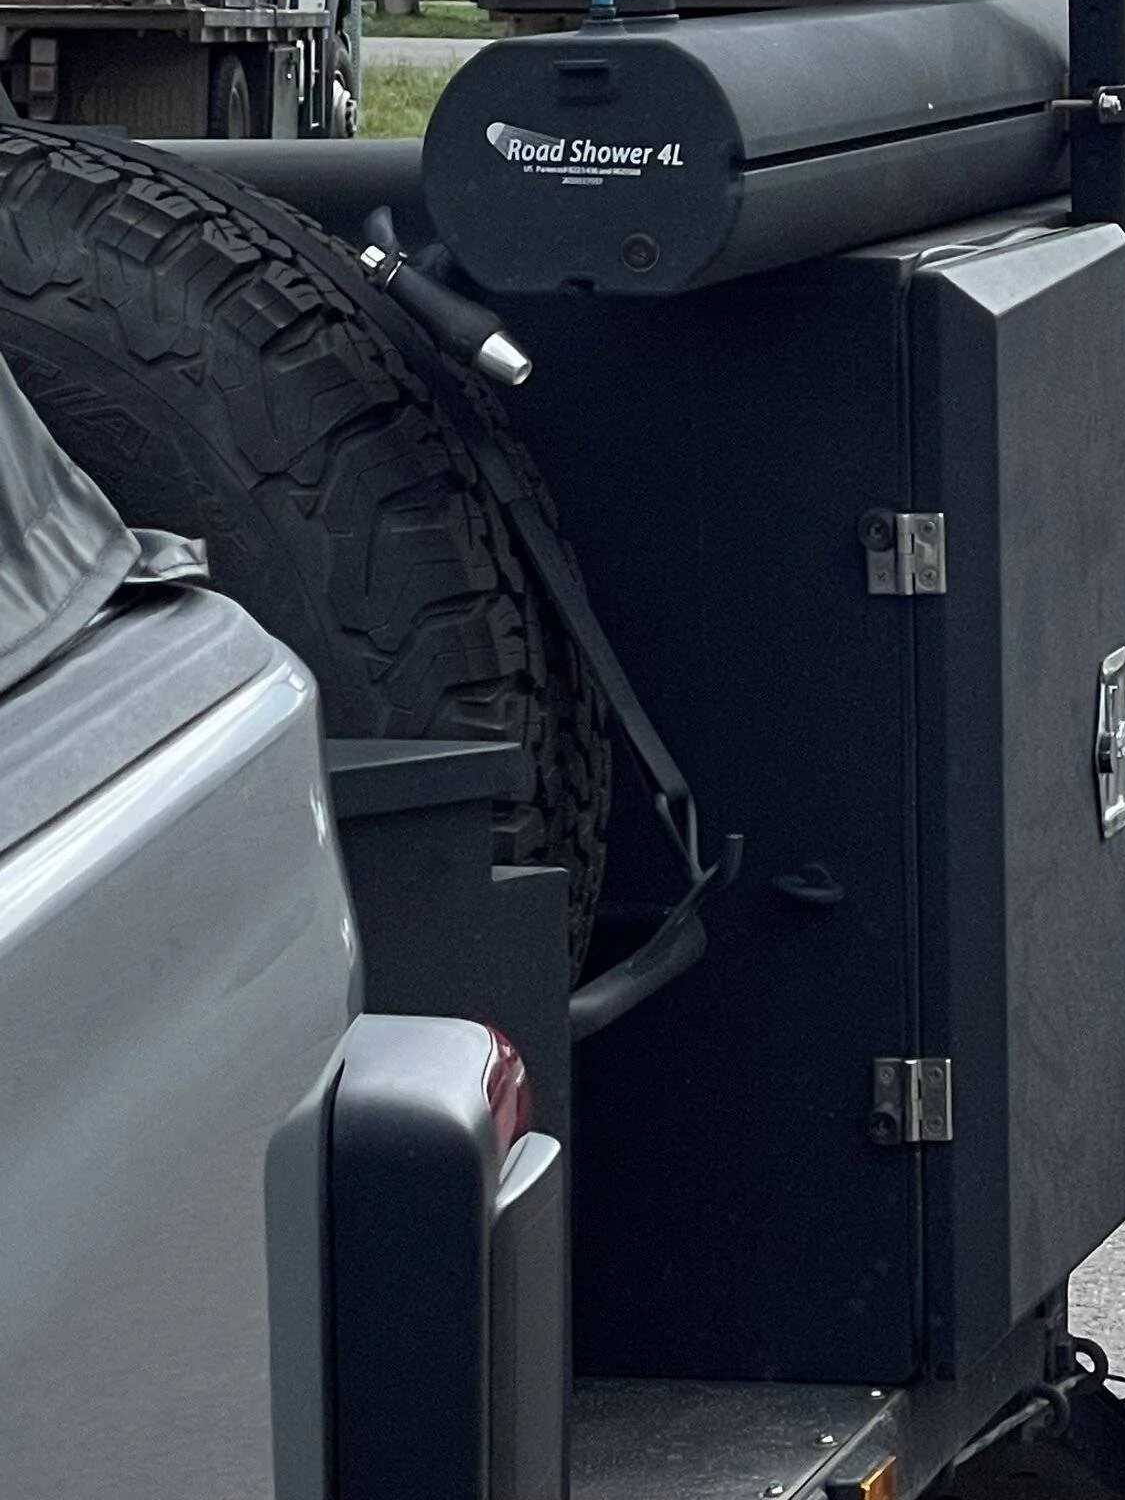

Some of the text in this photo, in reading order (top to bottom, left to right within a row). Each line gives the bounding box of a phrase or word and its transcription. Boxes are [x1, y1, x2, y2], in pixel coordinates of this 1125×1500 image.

[507, 138, 684, 166] Road Shower 4L
